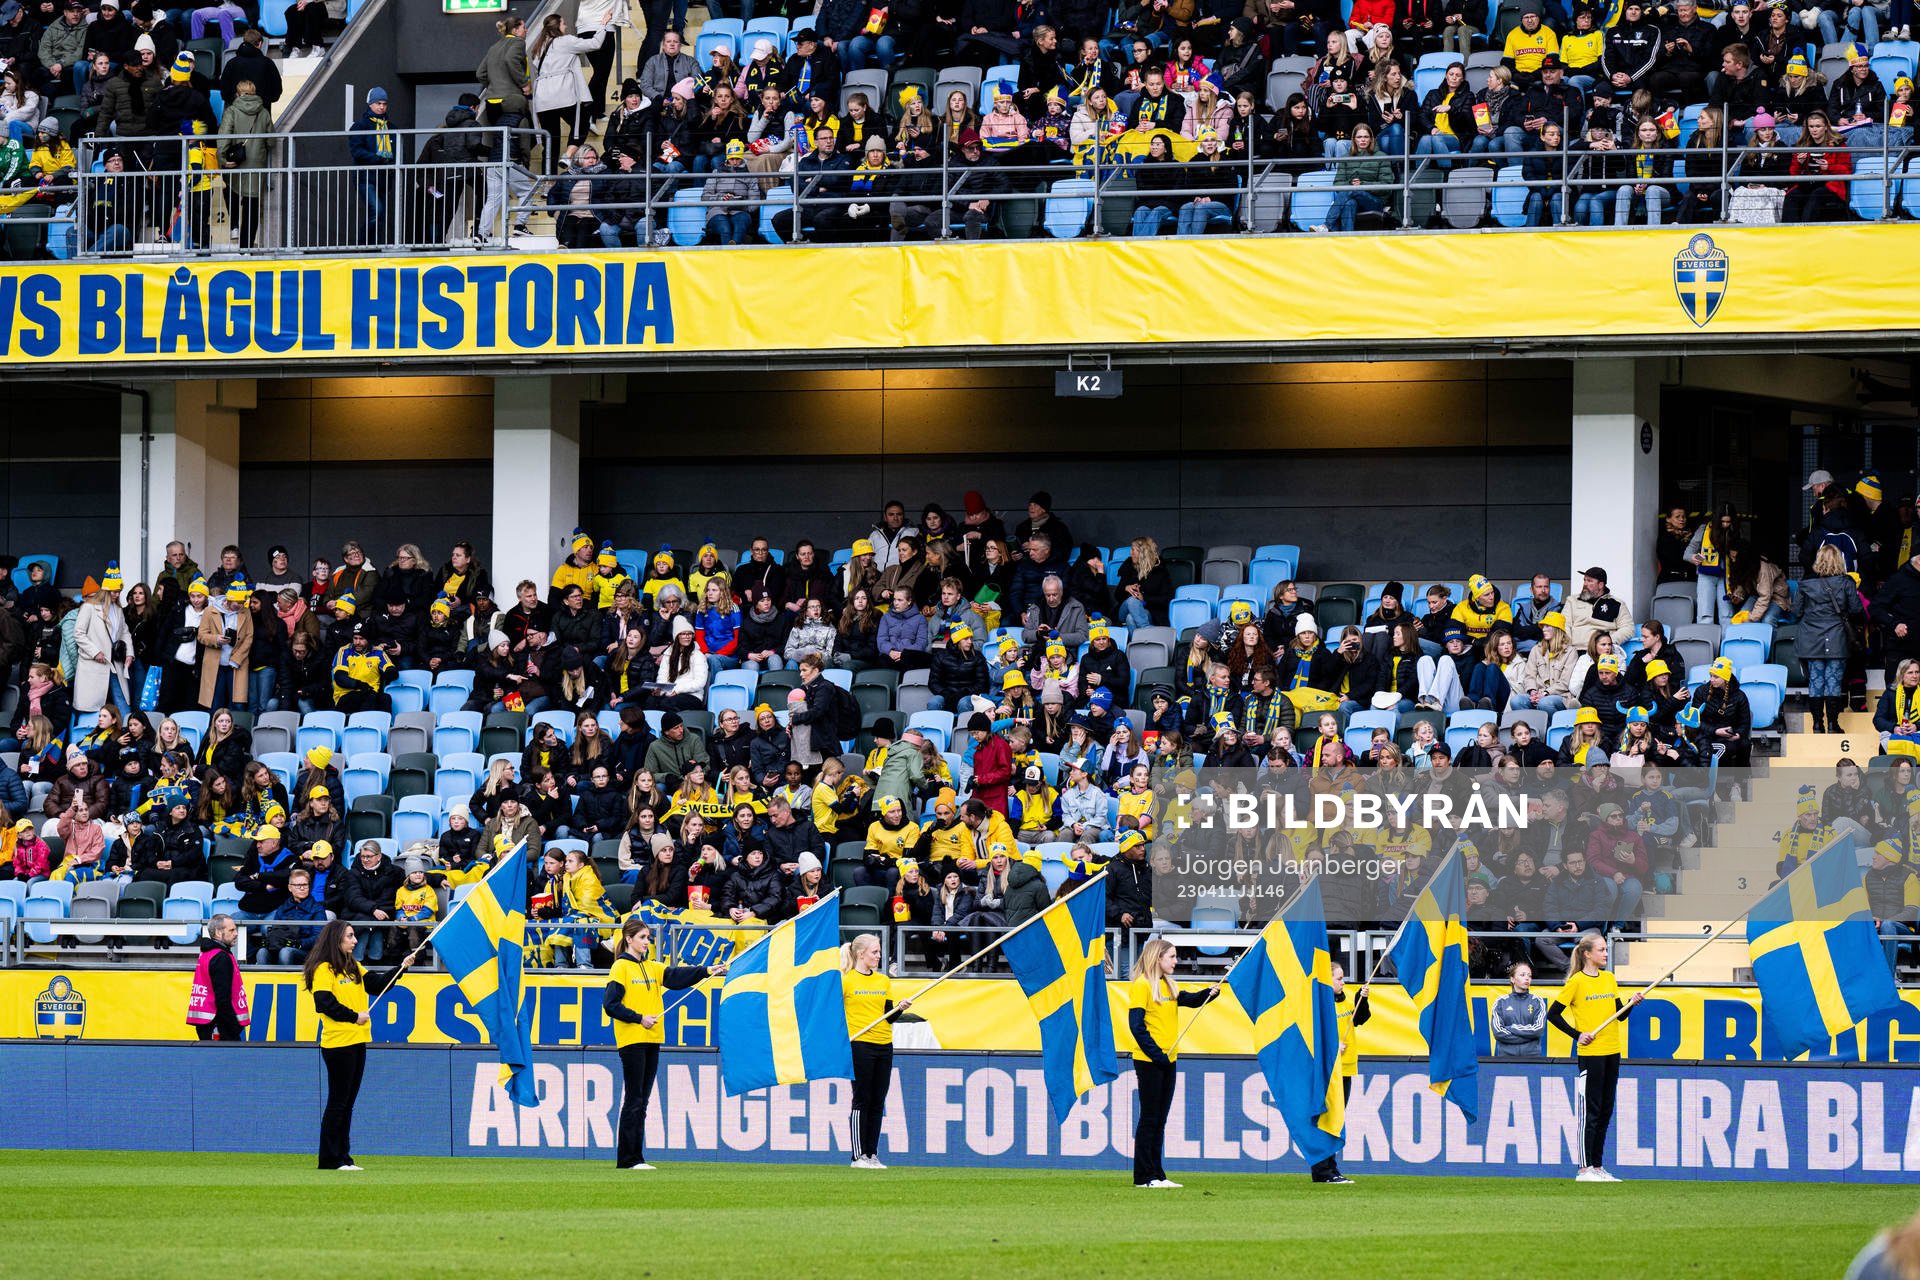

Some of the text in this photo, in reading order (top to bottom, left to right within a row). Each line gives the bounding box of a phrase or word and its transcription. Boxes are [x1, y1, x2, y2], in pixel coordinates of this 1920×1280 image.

[611, 90, 619, 101] 4
[1681, 260, 1720, 268] SVERIGE
[78, 266, 335, 355] BLÅGUL
[351, 262, 674, 350] HISTORIA
[1077, 375, 1101, 391] K2
[1840, 740, 1850, 752] 6
[680, 804, 735, 814] SWEDEN
[1738, 877, 1747, 890] 3
[42, 1003, 78, 1011] SVERIGE
[1616, 1076, 1789, 1170] LIRA
